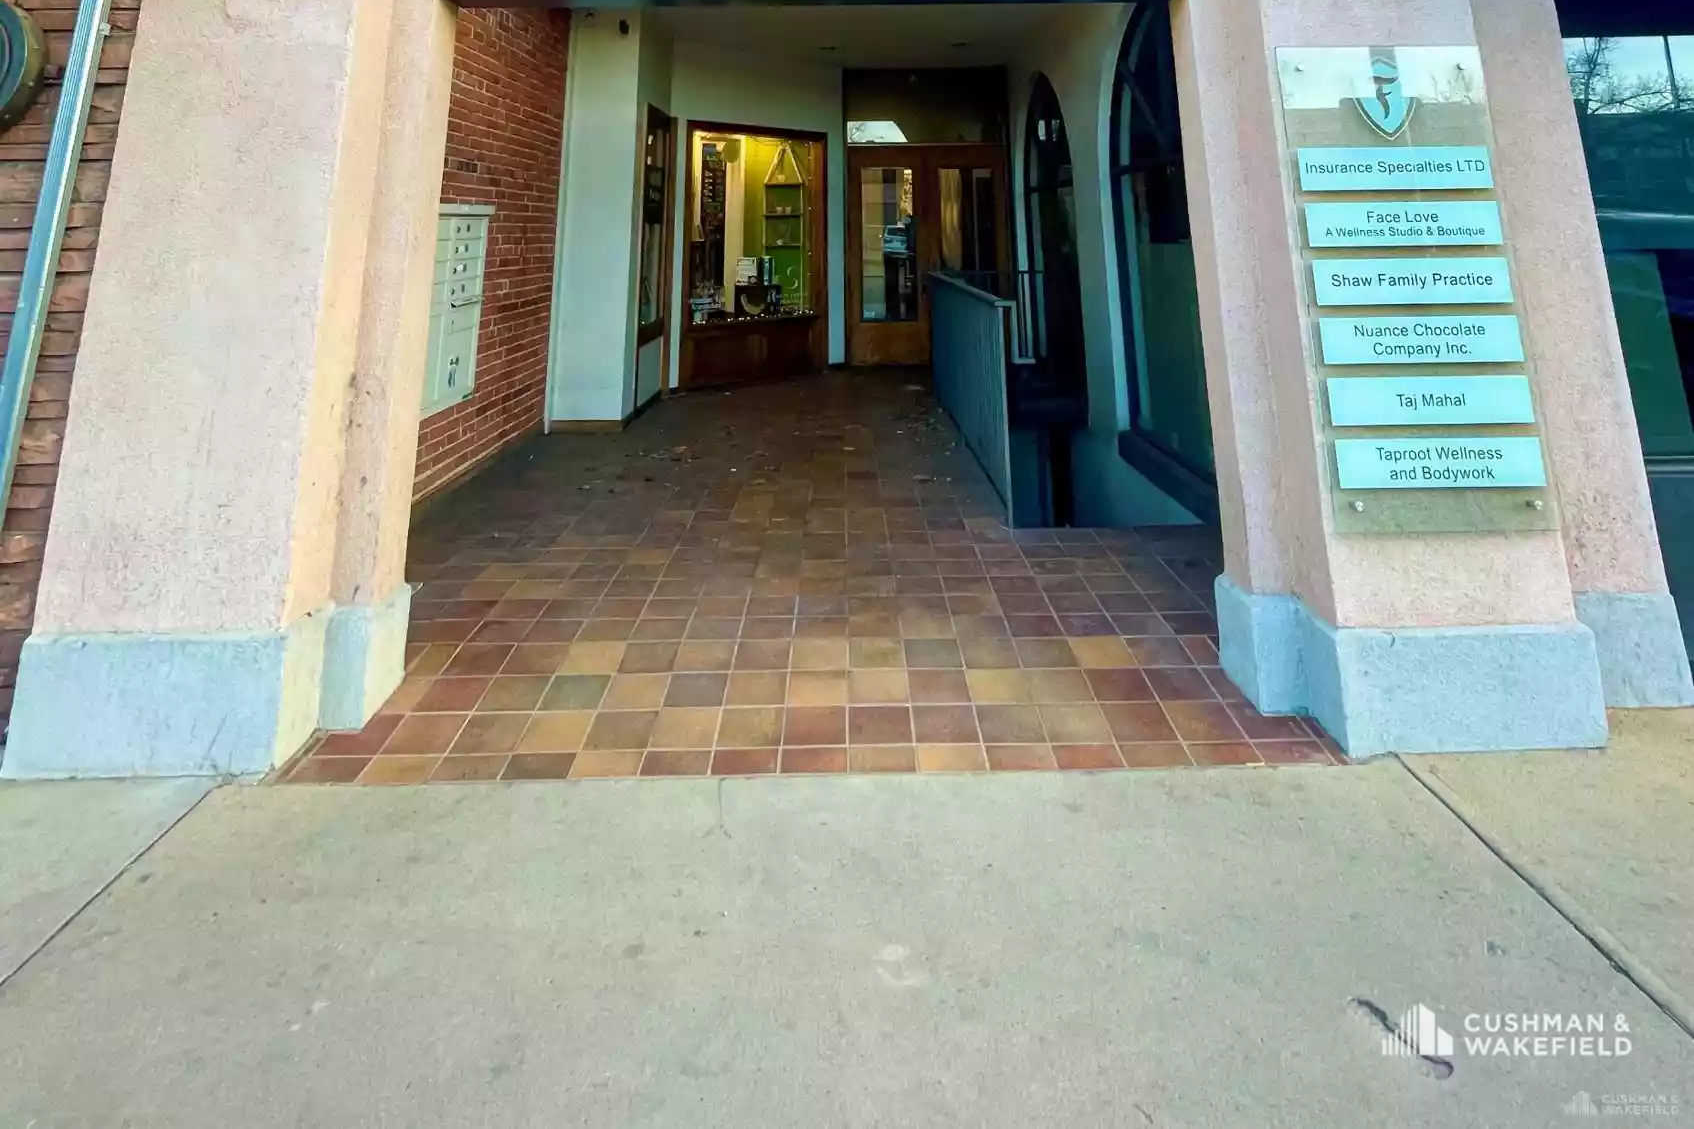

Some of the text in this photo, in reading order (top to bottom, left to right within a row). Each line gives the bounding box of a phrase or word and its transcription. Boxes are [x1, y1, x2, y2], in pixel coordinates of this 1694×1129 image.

[1305, 159, 1485, 175] Insurance Specialties LTD
[1366, 210, 1439, 223] Face Love
[1325, 225, 1485, 237] A Wellness Studio & Boutique
[1331, 272, 1493, 289] Shaw Family Practice
[1354, 323, 1485, 337] Nuance Chocolate
[1373, 342, 1472, 358] Company Inc.
[1396, 393, 1466, 410] Taj Mahal
[1376, 446, 1503, 464] Taproot Wellness
[1390, 466, 1495, 482] and Bodywork
